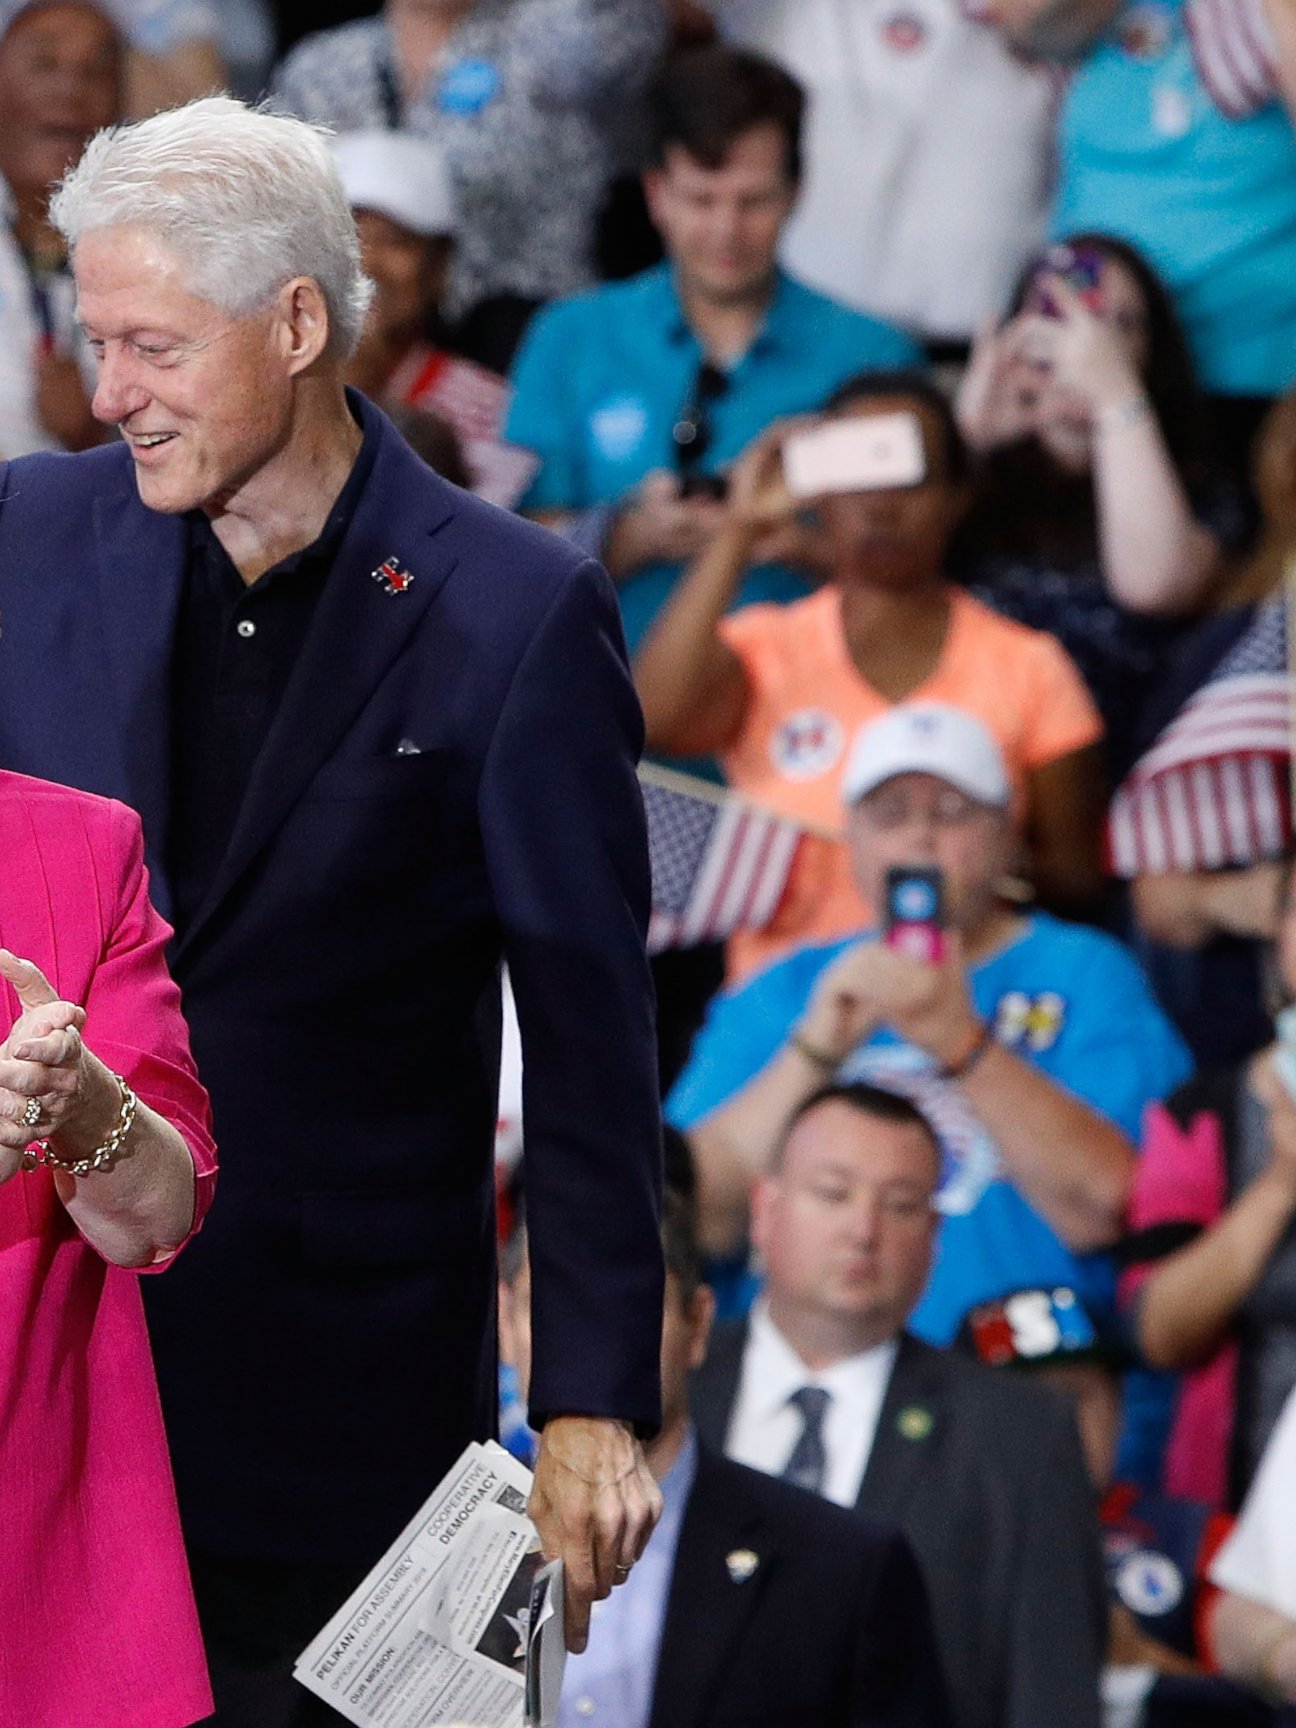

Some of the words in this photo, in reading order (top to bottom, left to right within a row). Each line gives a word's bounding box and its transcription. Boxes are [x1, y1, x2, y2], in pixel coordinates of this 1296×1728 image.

[425, 1461, 487, 1537] COOPERATIVE
[438, 1470, 499, 1545] DEMOCRACY
[315, 1631, 356, 1681] PELIKAN
[351, 1609, 373, 1634] FOR
[369, 1554, 415, 1611] ASSEMBLY
[330, 1657, 357, 1690] OFFICIAL
[354, 1617, 388, 1658] PLATFORM
[383, 1582, 415, 1620] SUMMARY
[349, 1683, 368, 1704] OUR
[364, 1645, 396, 1684] MISSION:
